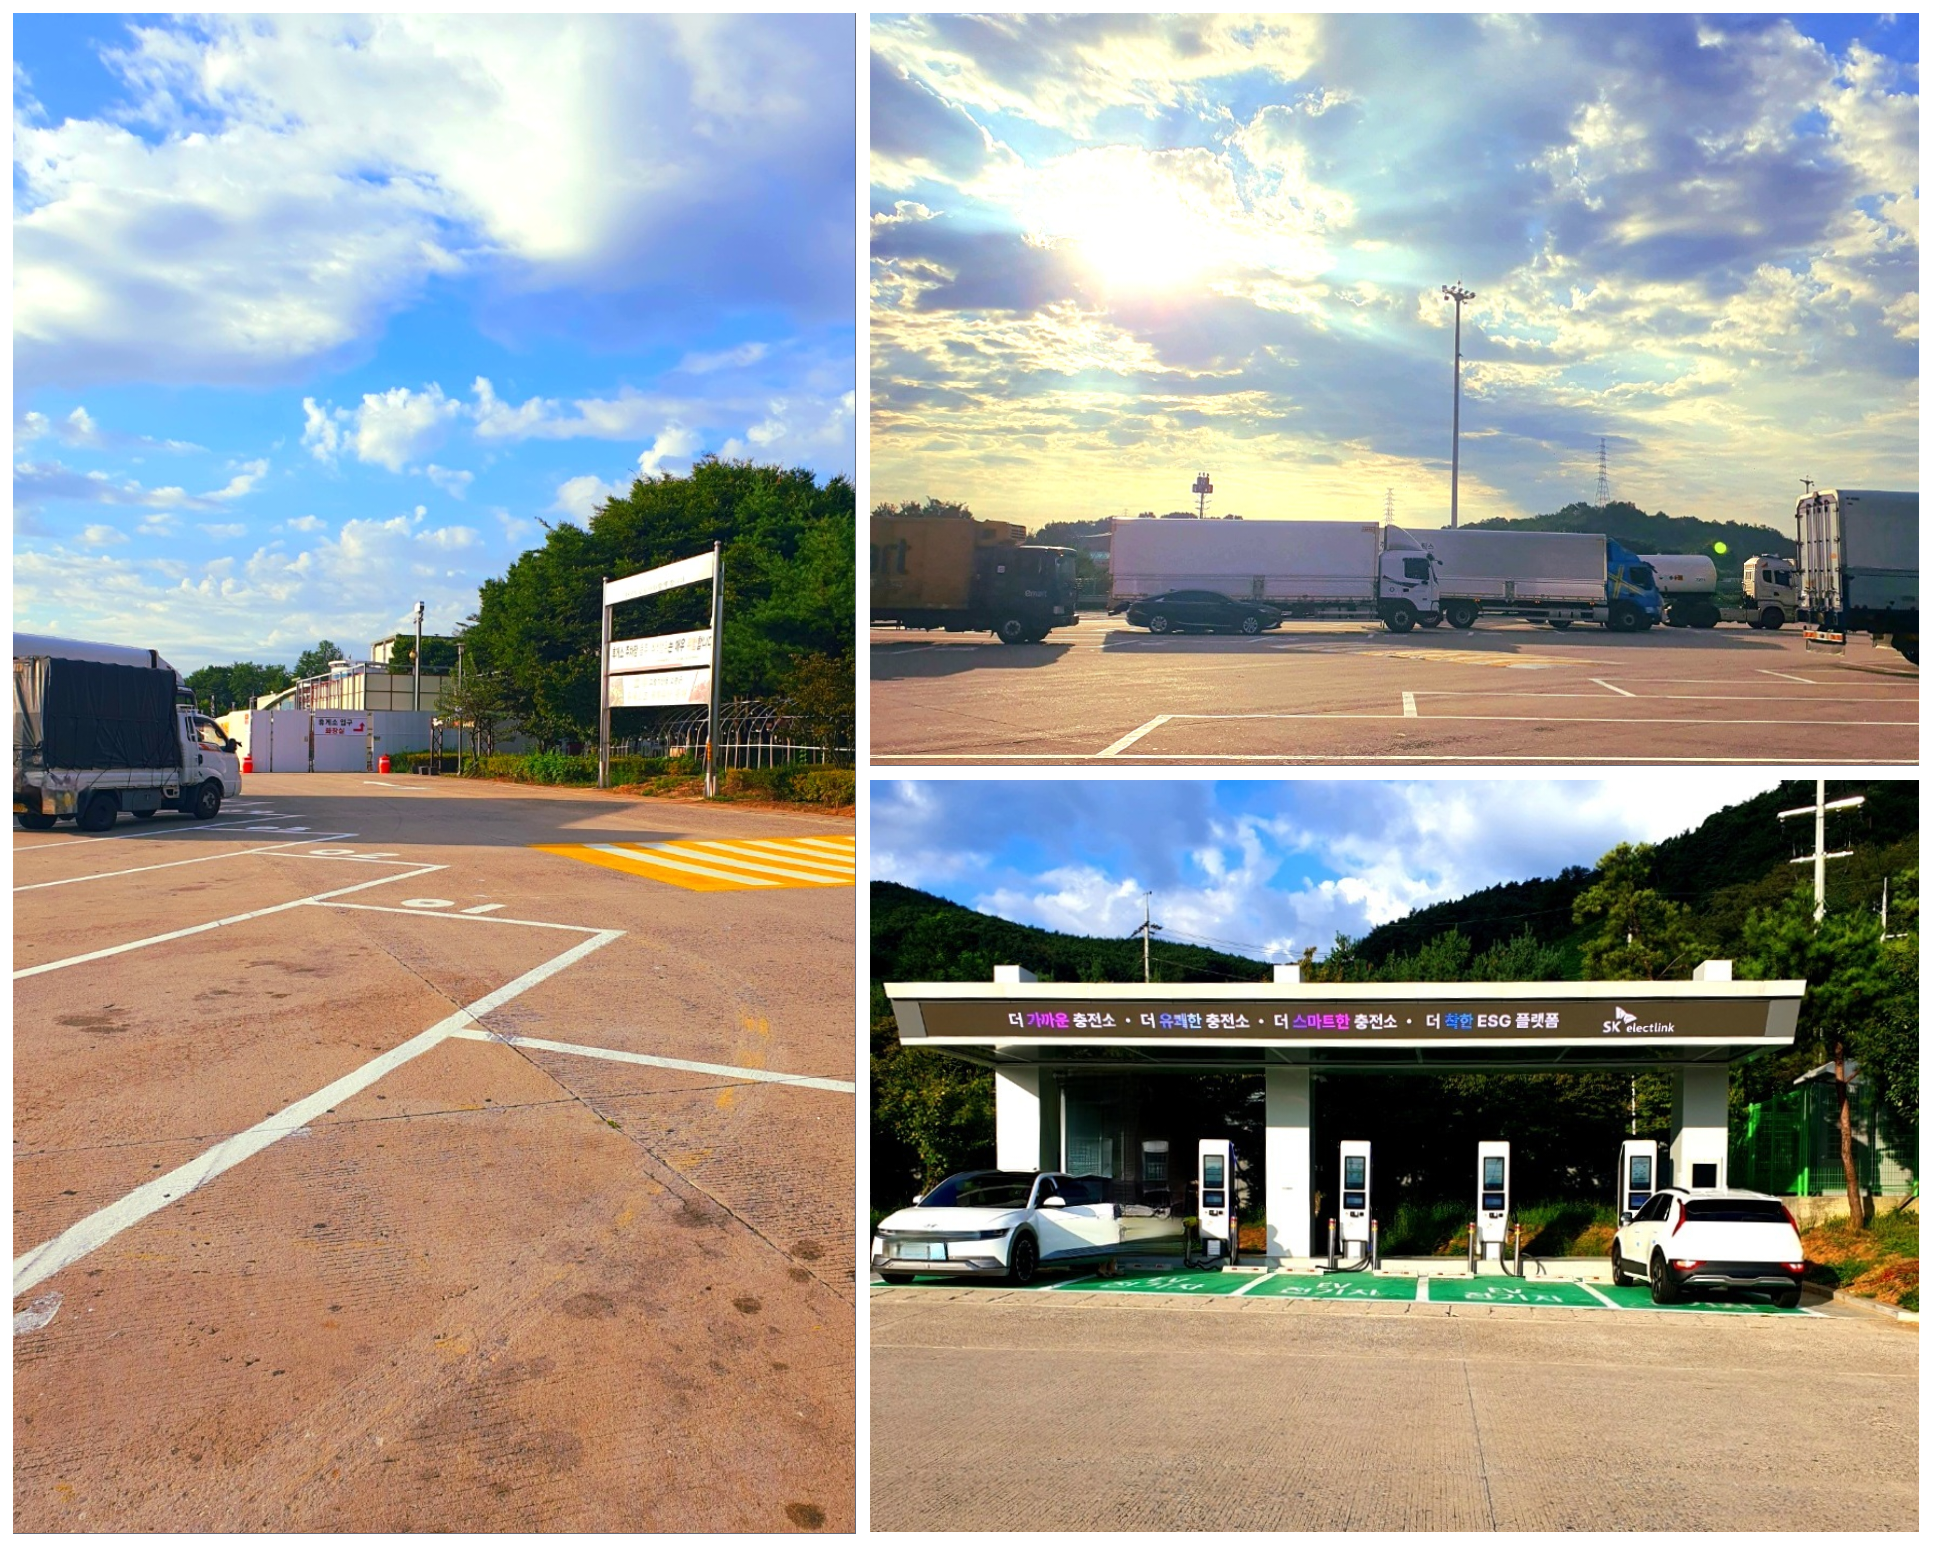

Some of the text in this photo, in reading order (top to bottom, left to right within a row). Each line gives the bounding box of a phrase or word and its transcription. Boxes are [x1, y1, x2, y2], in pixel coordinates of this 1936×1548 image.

[1008, 1012, 1560, 1030] 더 가까운 충전소 더 유쾌한 충전소 더 스마트한 충전소 더 착한 ESG 플랫폼
[1602, 1021, 1675, 1033] SK electlink
